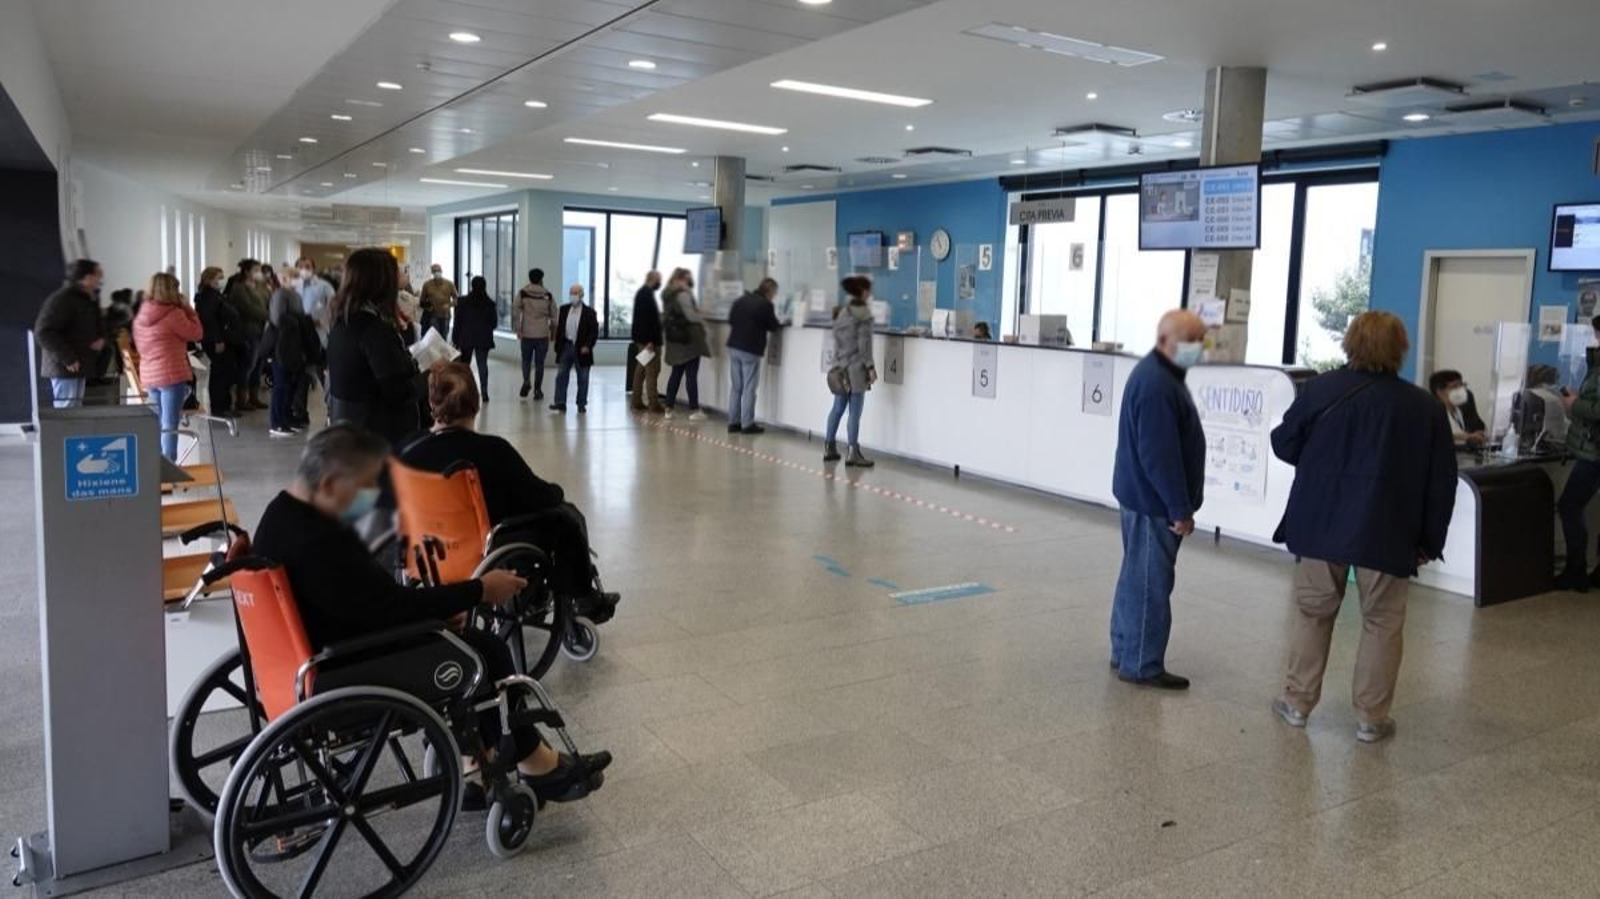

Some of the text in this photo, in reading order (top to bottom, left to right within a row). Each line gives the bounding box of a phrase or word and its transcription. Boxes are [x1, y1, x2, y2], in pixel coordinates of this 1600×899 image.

[1020, 208, 1065, 221] CITA PREVIA
[980, 246, 991, 269] 5
[1072, 247, 1084, 268] 6
[889, 358, 898, 375] 4
[979, 369, 989, 388] 5
[1091, 384, 1103, 404] 6
[72, 487, 132, 498] das mans
[78, 479, 126, 488] Hixiene
